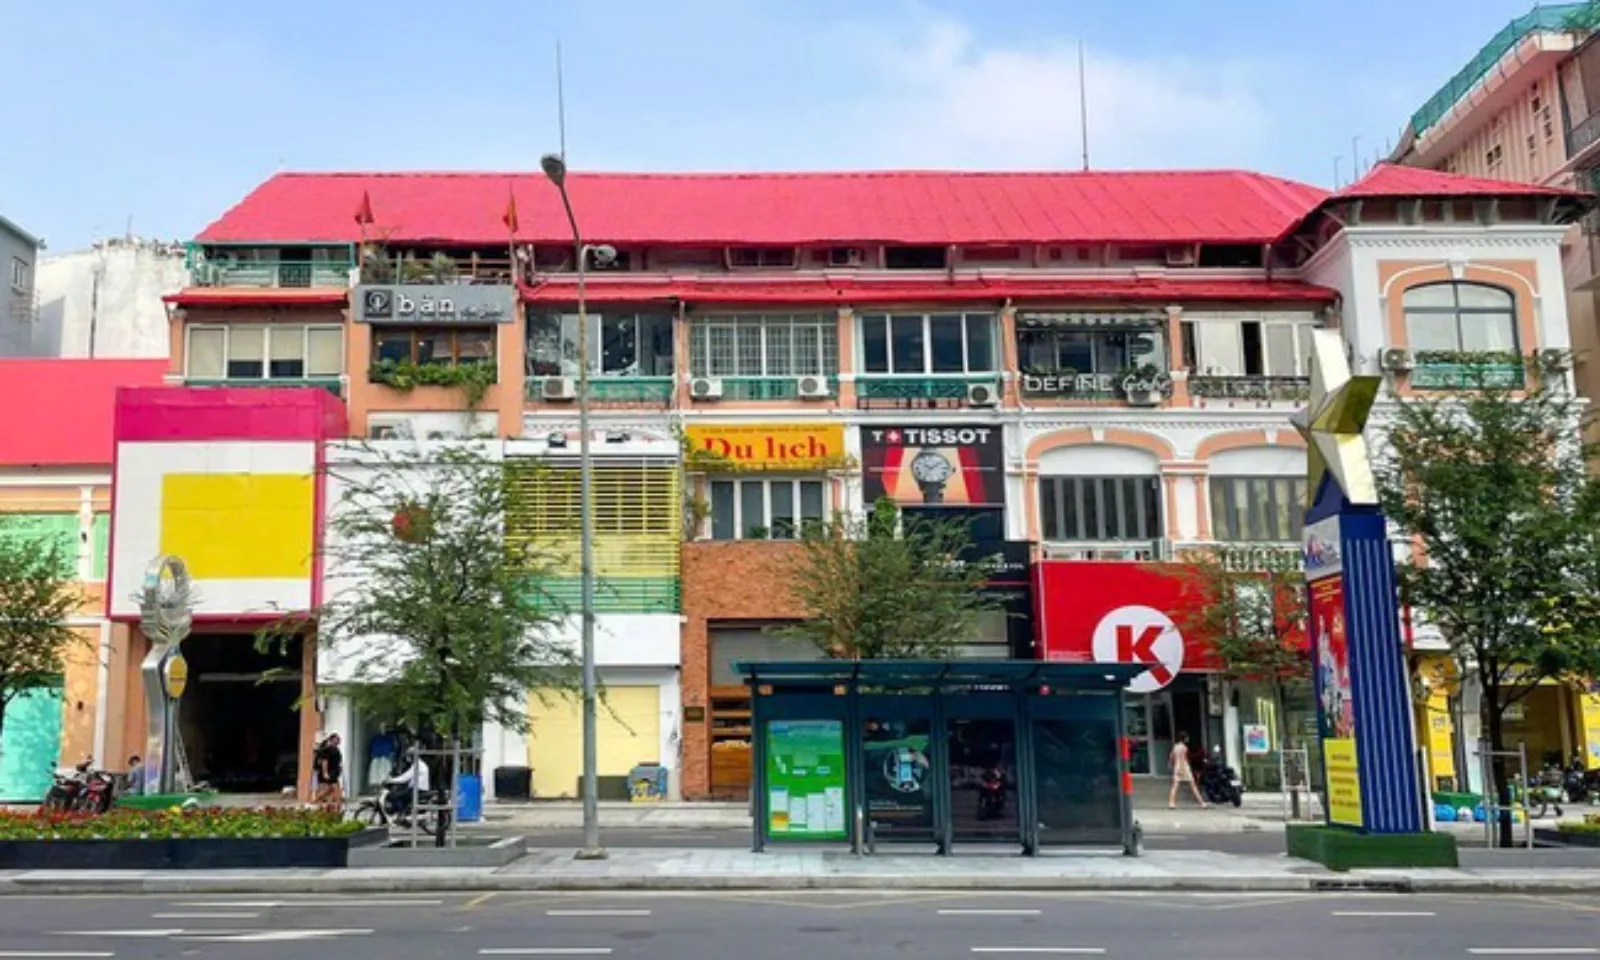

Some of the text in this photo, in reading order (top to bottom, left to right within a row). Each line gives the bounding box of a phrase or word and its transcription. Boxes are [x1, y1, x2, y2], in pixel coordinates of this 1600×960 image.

[1024, 374, 1114, 391] DEFINE
[903, 428, 991, 444] TISSOT
[1115, 624, 1174, 687] K
